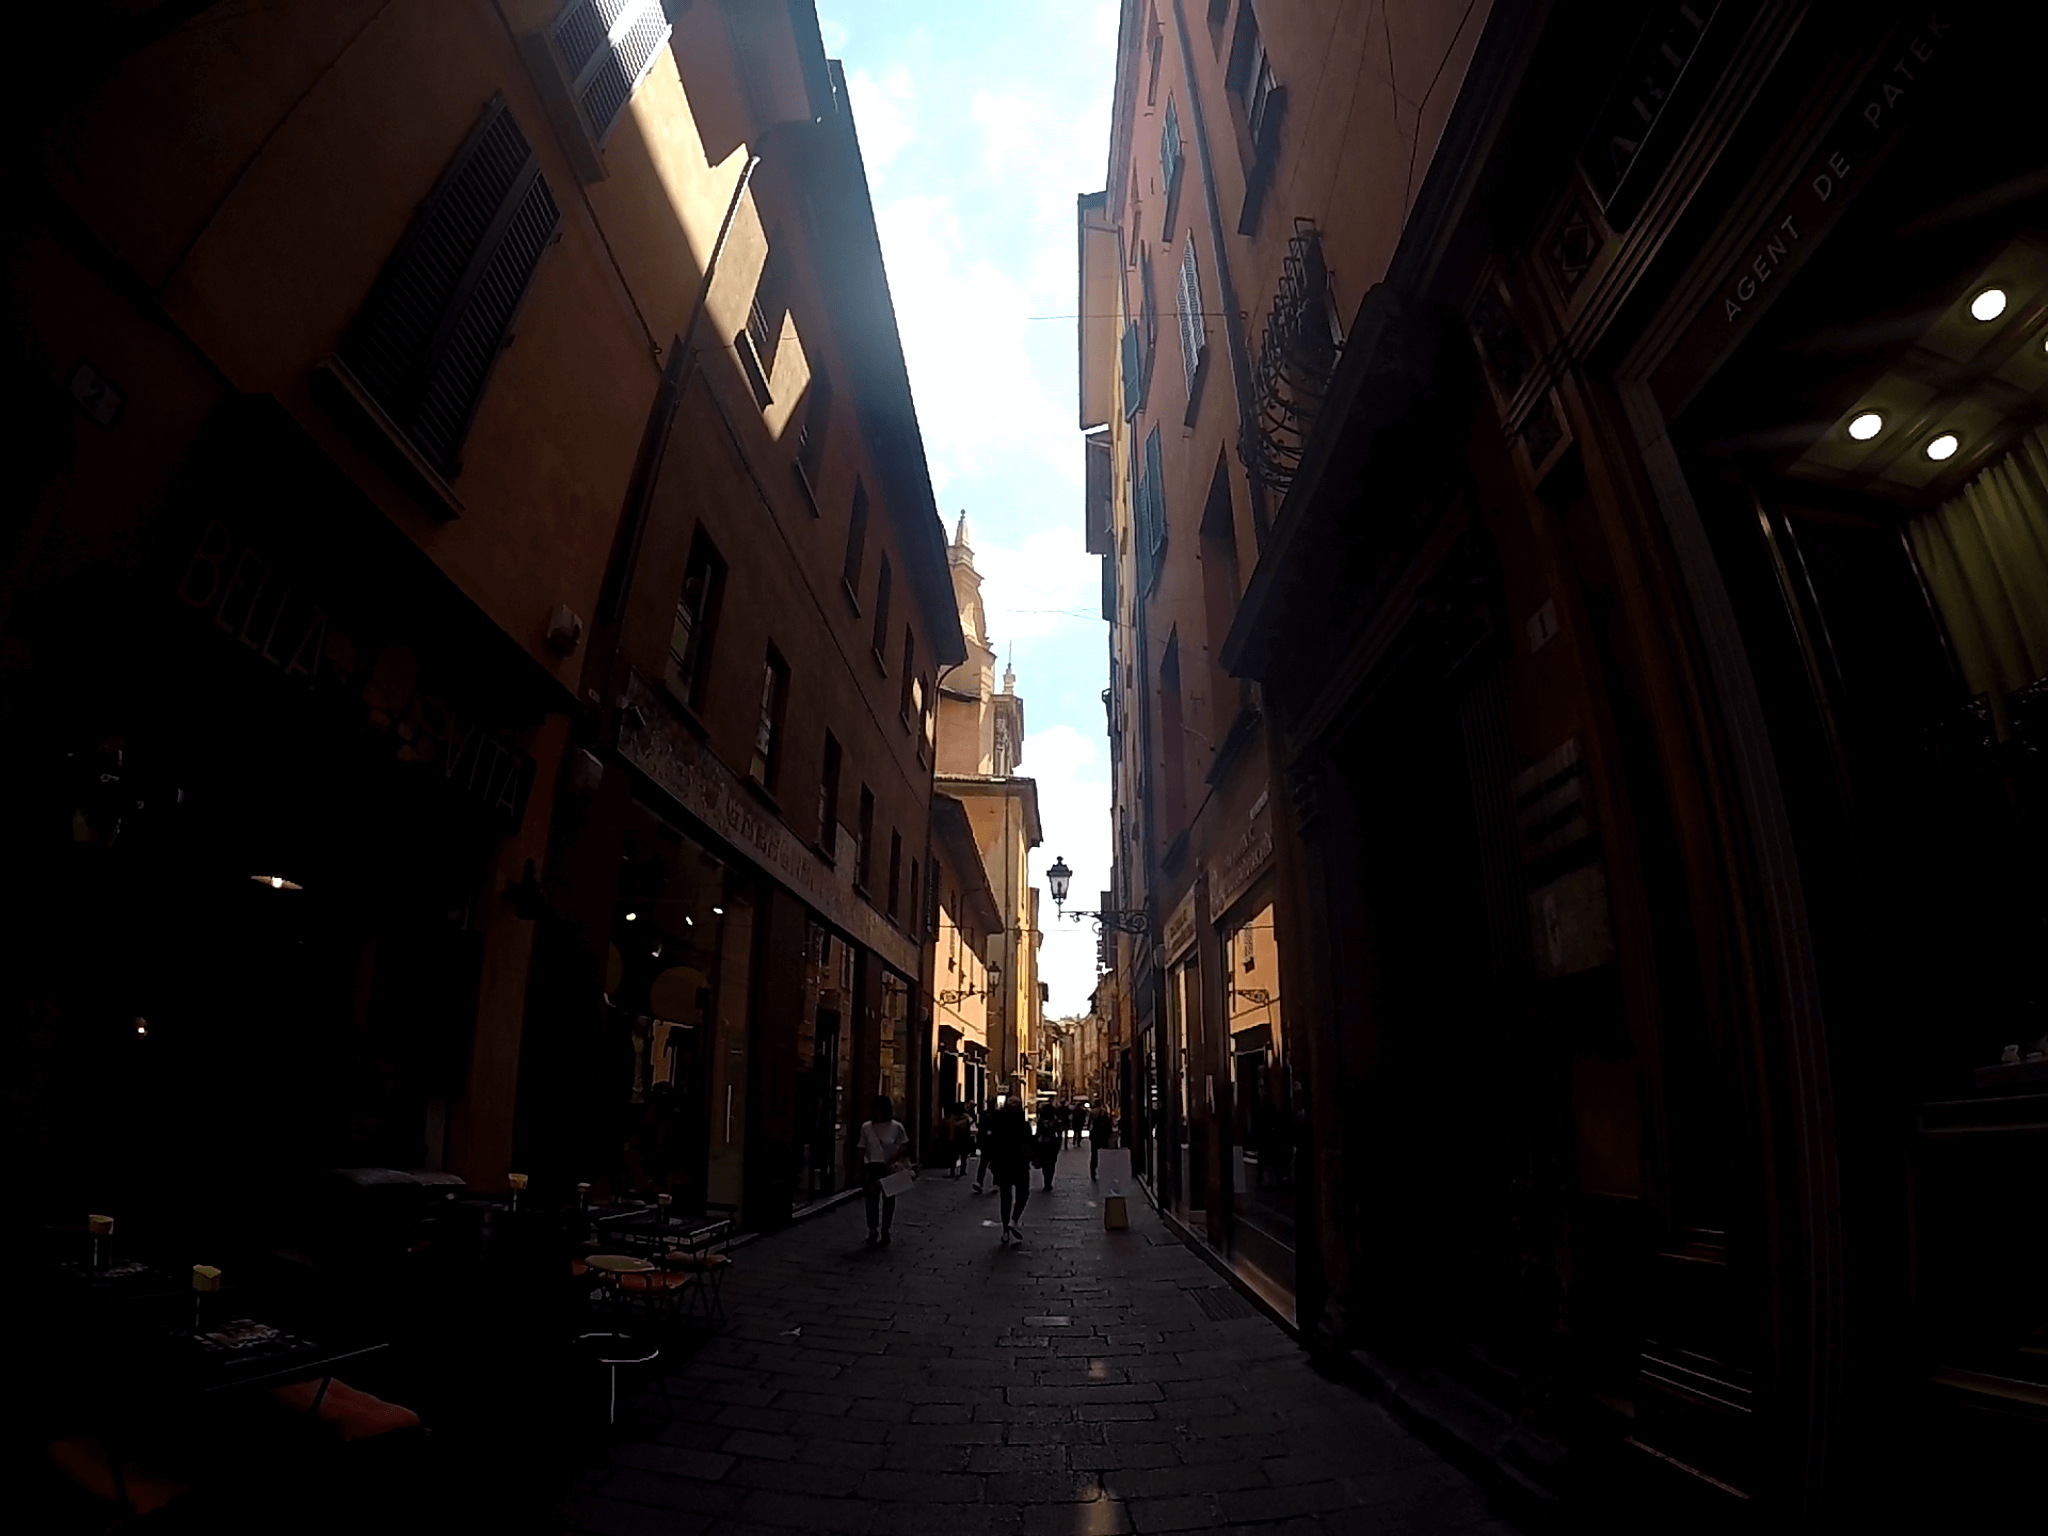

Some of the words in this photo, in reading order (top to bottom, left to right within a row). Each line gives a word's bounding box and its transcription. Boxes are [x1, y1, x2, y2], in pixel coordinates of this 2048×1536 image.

[1724, 214, 1799, 322] AGENT
[1812, 150, 1851, 203] DE
[1862, 11, 1950, 129] PATEK
[80, 378, 106, 413] 2
[176, 517, 329, 677] BELLA
[443, 710, 523, 816] VITA
[1536, 611, 1548, 641] 1
